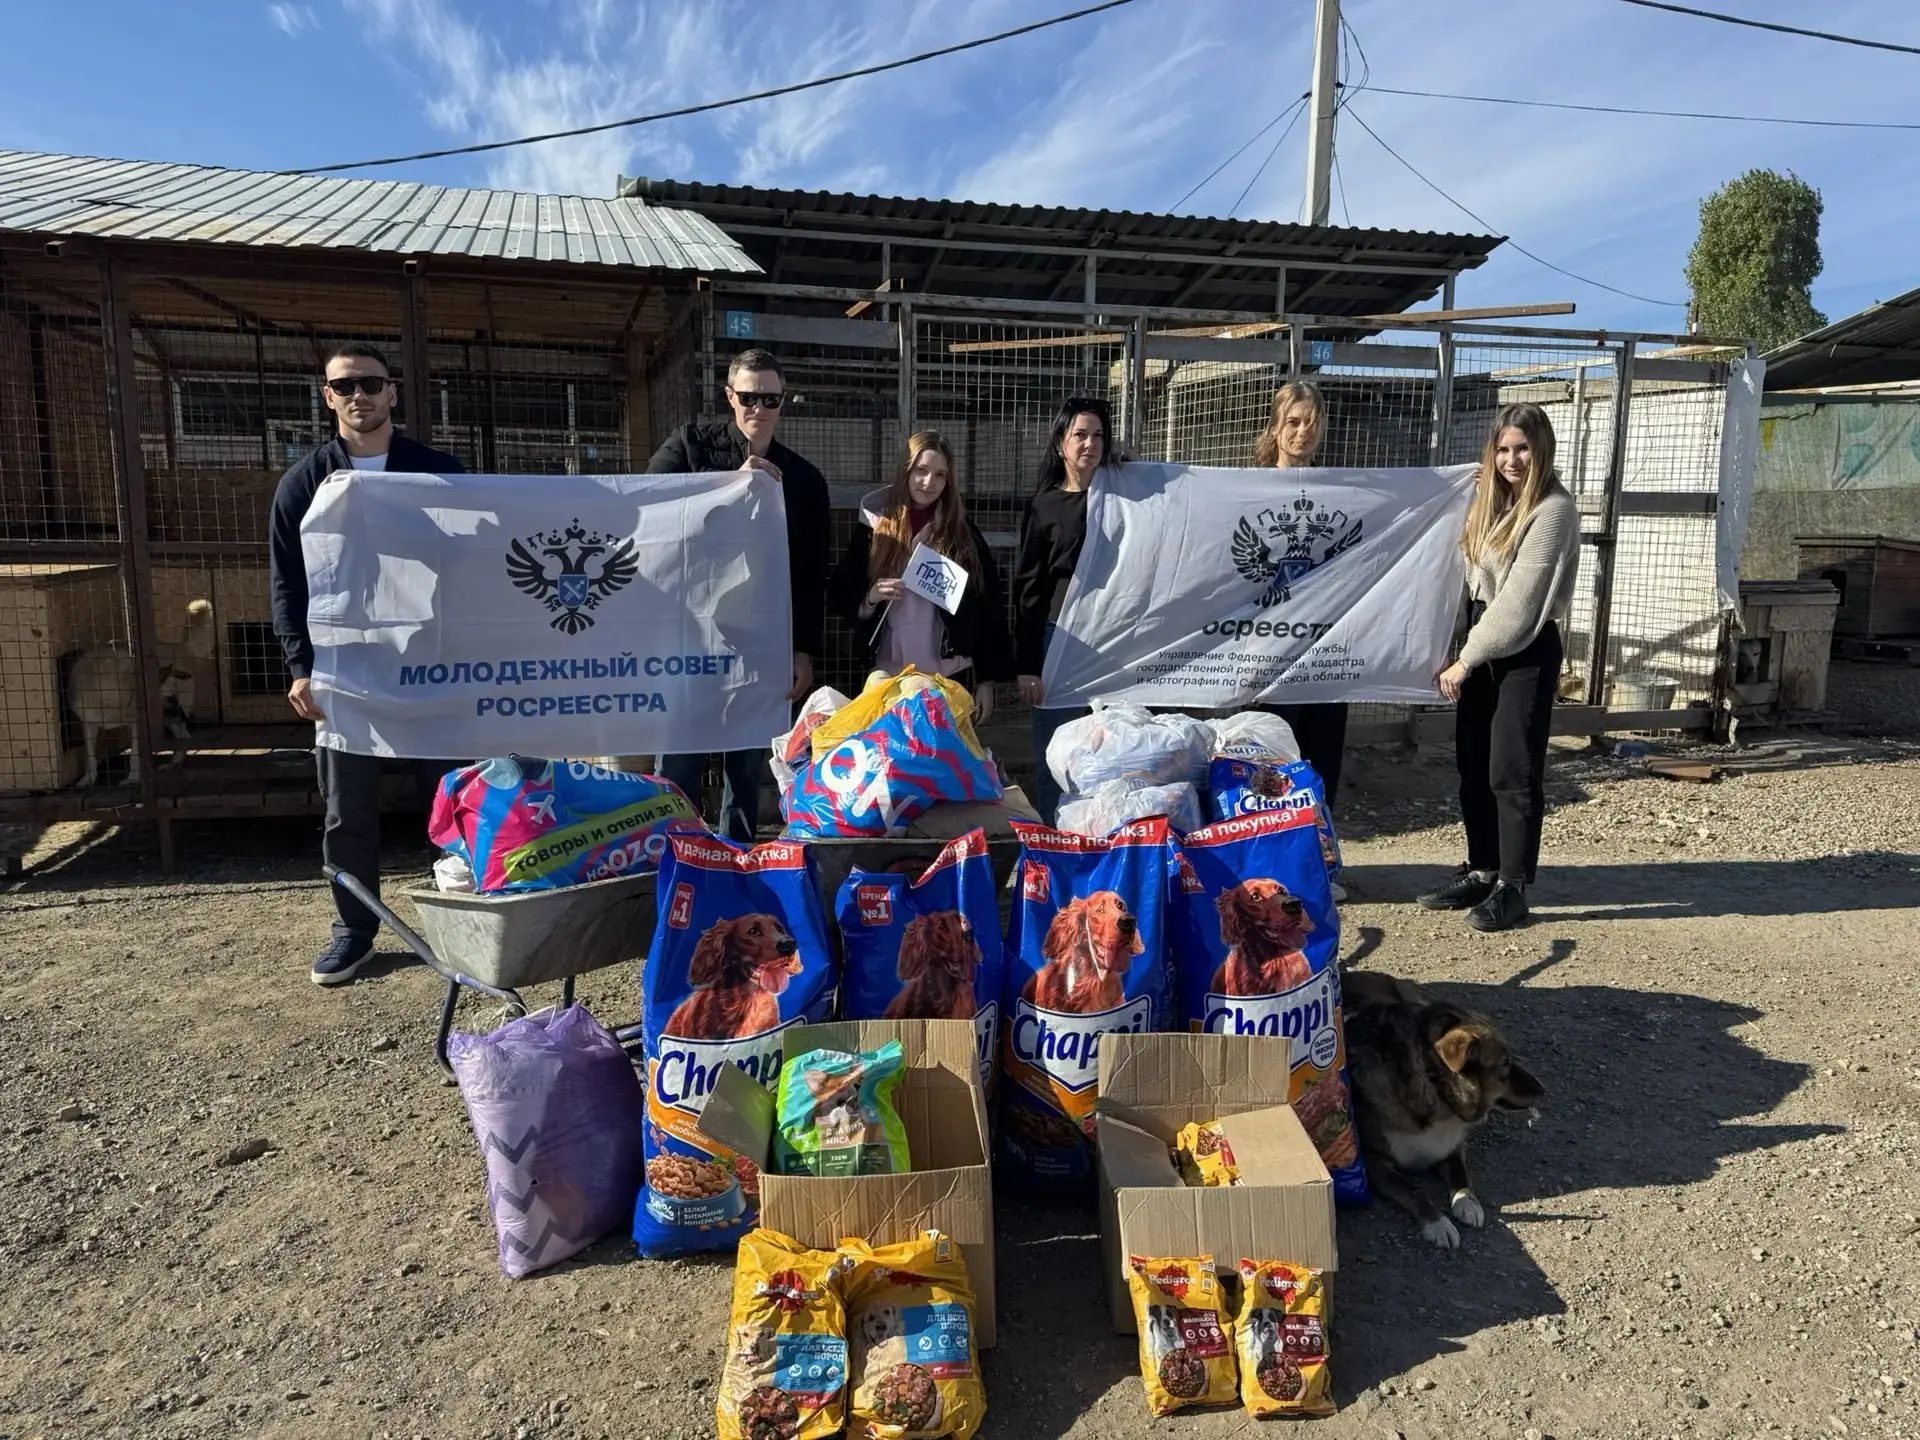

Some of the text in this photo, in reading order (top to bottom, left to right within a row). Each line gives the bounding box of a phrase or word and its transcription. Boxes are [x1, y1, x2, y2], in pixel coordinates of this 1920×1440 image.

[730, 317, 750, 332] 45
[1314, 346, 1330, 360] 46
[1159, 651, 1224, 662] Управление
[1307, 643, 1347, 656] лужбы
[400, 651, 735, 686] МОЛОДЕЖНЫЙ СОВЕТ
[1136, 658, 1365, 676] государственной регистраии, кадастра
[1146, 677, 1219, 687] картографии
[1221, 679, 1236, 687] по
[1312, 671, 1360, 682] области
[477, 692, 668, 718] РОСРЕЕСТРА
[1217, 809, 1299, 837] покупка!
[515, 833, 589, 873] товары
[592, 825, 604, 841] и
[607, 807, 656, 835] отели
[656, 803, 674, 817] за
[609, 826, 682, 872] OZO
[675, 839, 731, 862] Удачная
[586, 858, 611, 882] на
[1149, 1274, 1197, 1286] Pedigree
[1260, 1276, 1306, 1290] Pedigree
